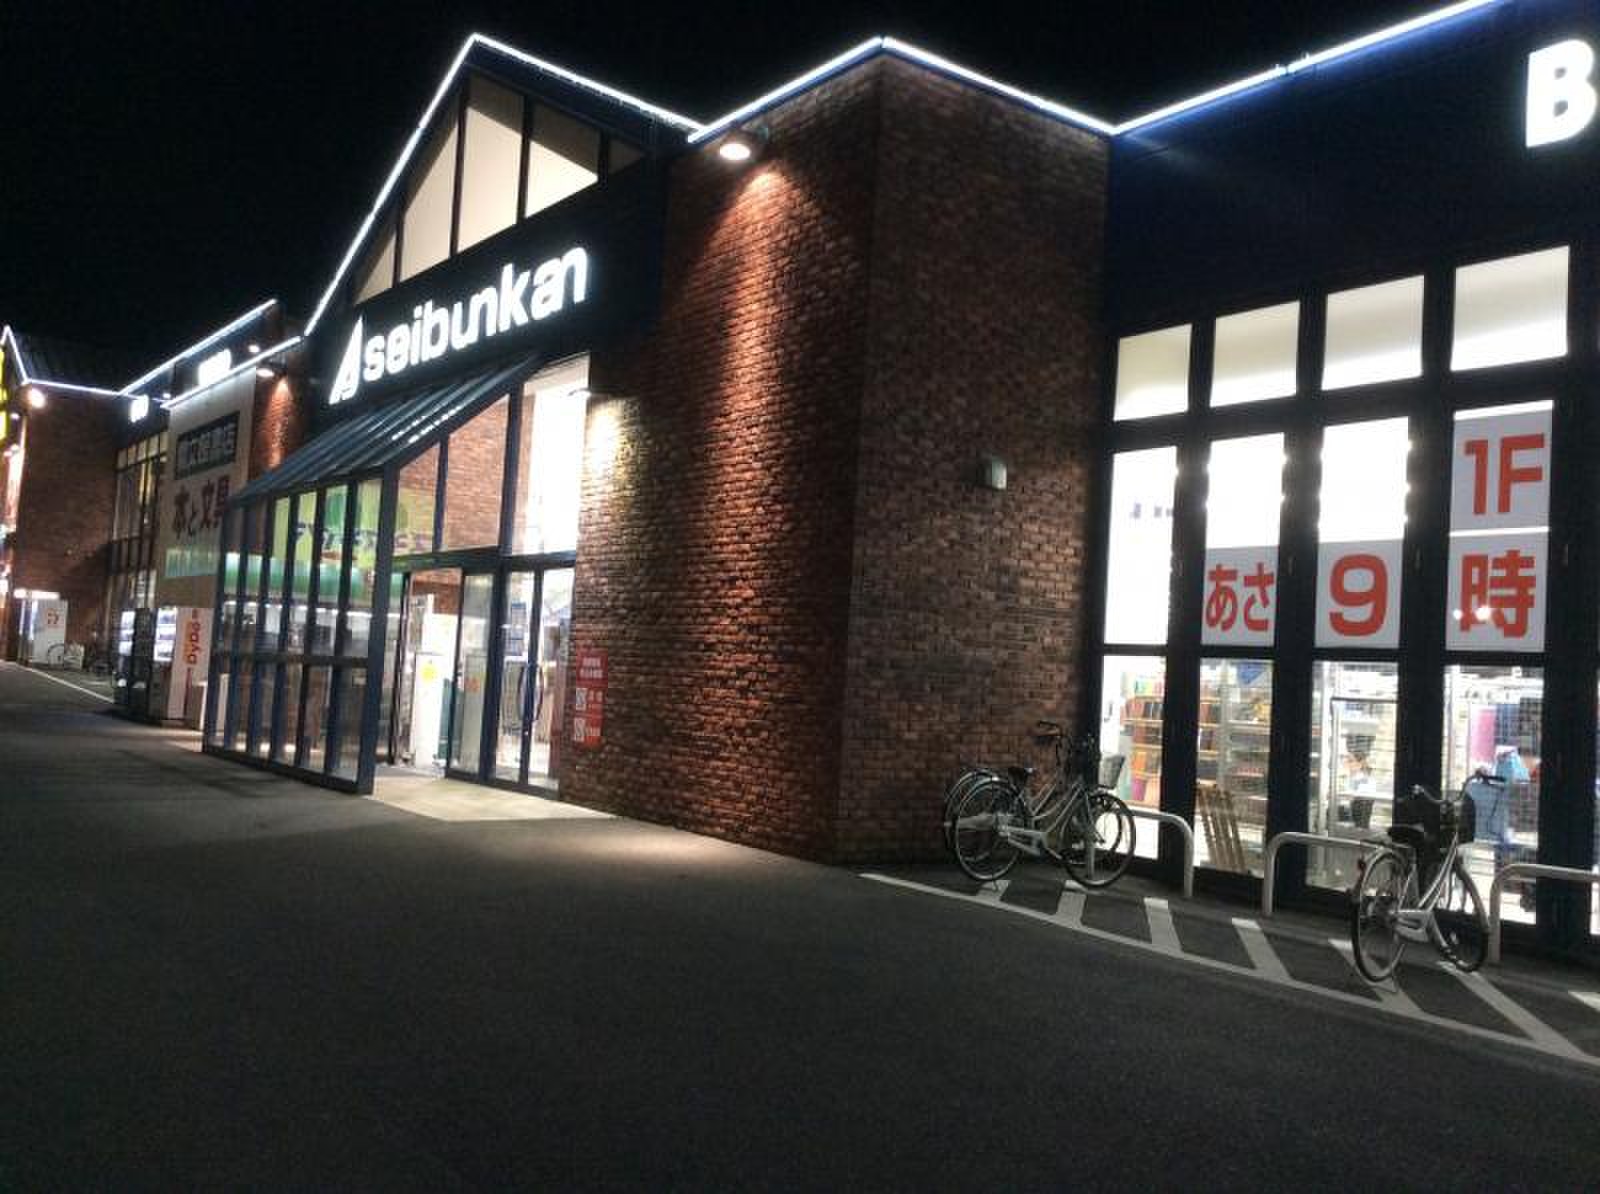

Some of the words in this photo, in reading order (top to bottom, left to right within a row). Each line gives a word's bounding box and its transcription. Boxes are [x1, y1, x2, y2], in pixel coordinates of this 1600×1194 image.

[1526, 39, 1598, 148] B
[363, 246, 588, 382] seibunkan
[1463, 432, 1546, 516] 1F
